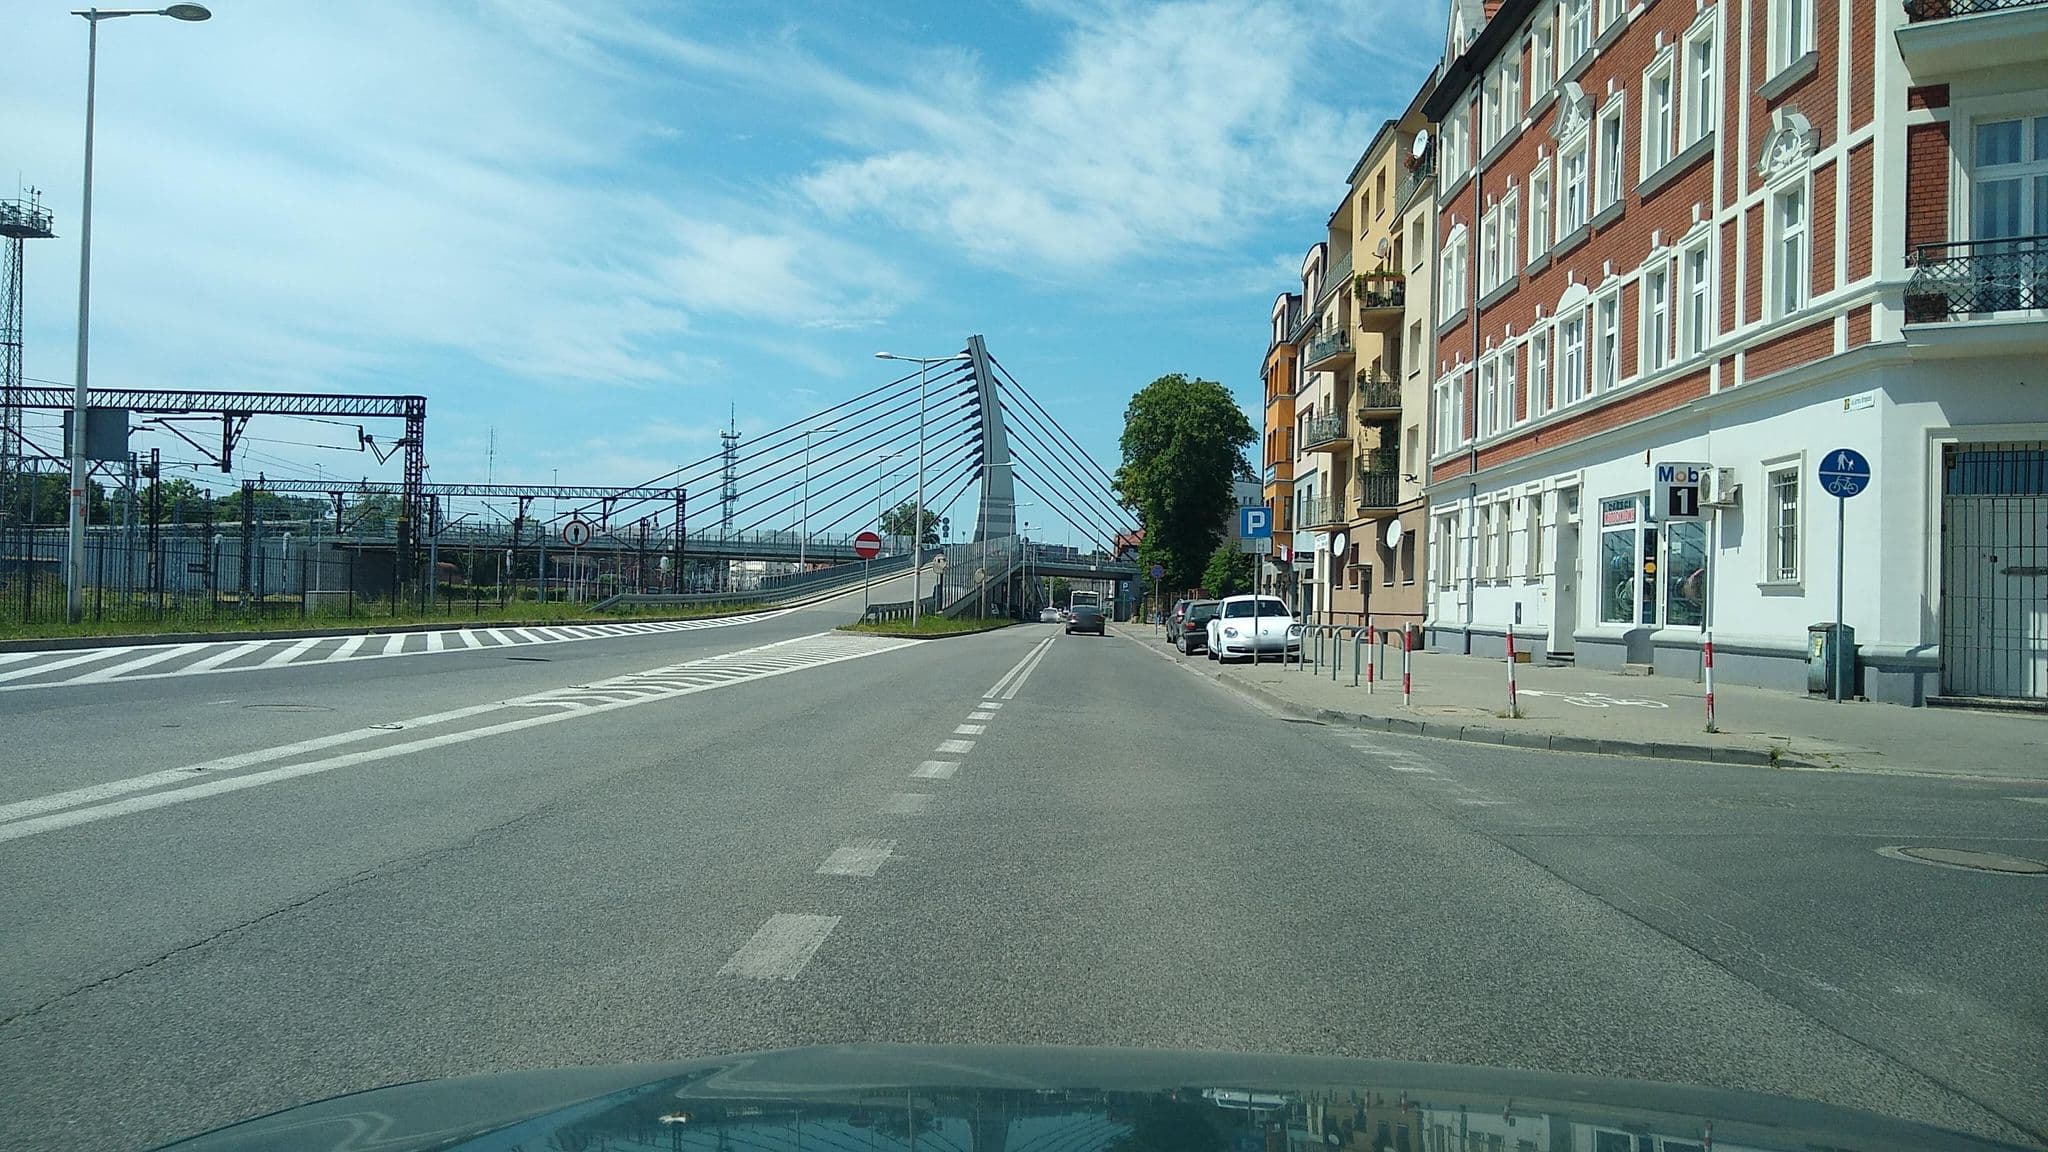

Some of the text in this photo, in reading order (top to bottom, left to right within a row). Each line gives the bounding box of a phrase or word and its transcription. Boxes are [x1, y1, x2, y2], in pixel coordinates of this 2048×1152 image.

[1659, 466, 1710, 483] Mob
[1676, 488, 1689, 515] 1
[1247, 510, 1265, 535] P
